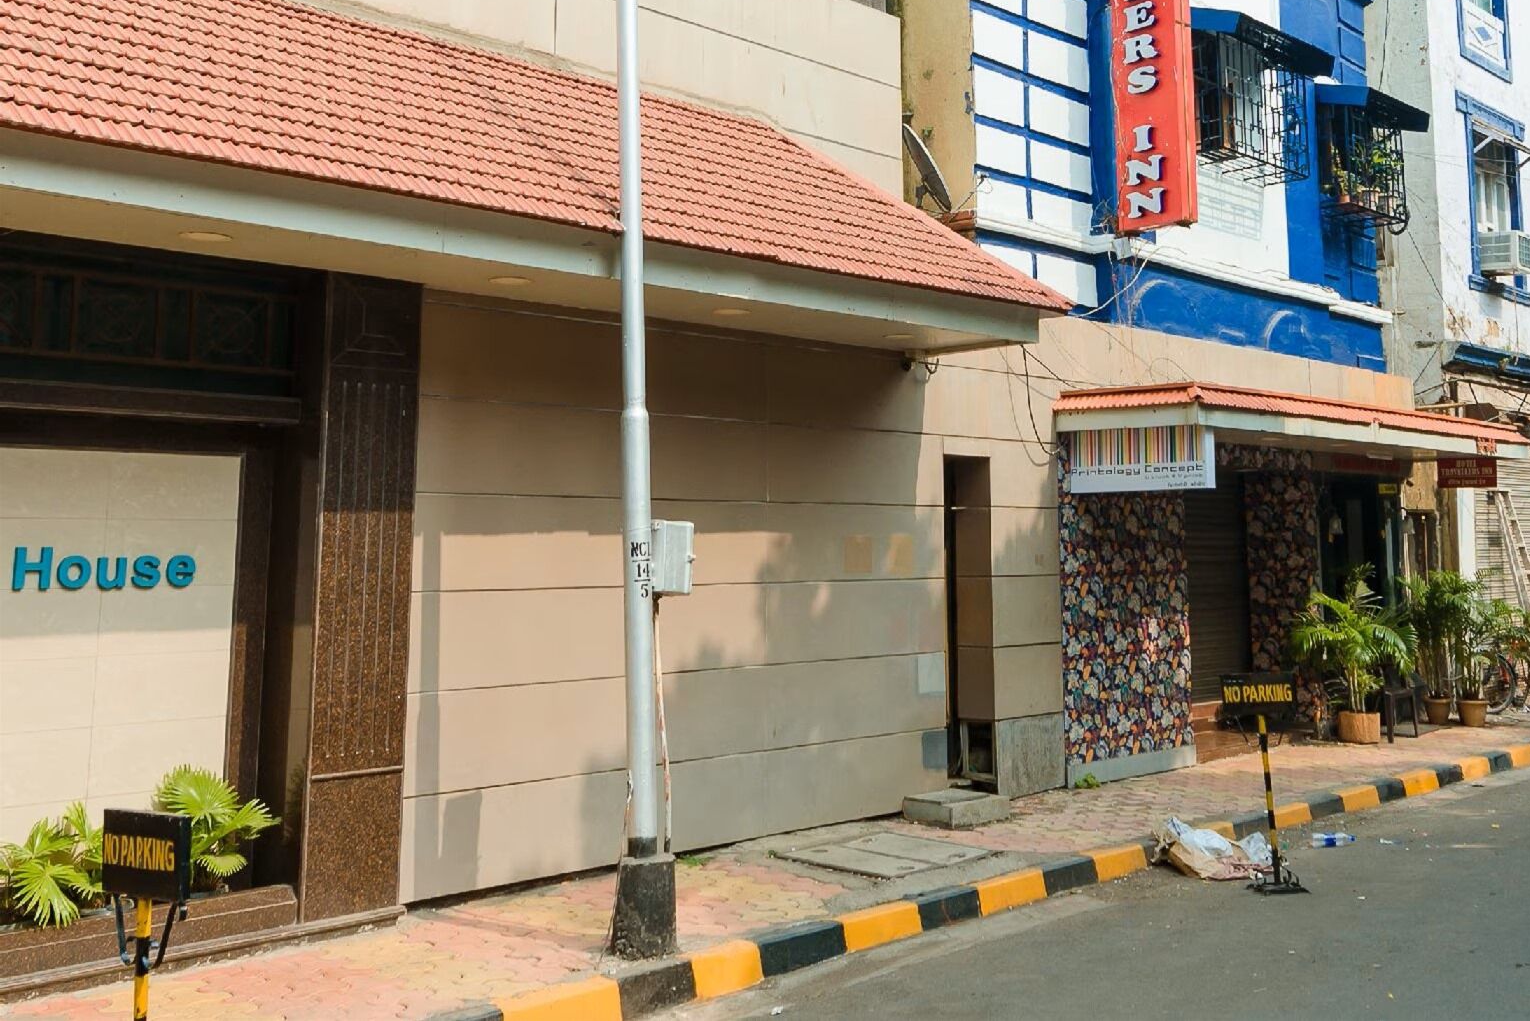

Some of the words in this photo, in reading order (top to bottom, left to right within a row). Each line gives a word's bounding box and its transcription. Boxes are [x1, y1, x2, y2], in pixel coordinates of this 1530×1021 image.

[1125, 124, 1164, 220] INN
[1071, 466, 1141, 477] Printology
[1144, 462, 1204, 474] Concept
[11, 546, 197, 592] House
[640, 583, 649, 599] 5
[1223, 685, 1241, 704] NO
[1242, 682, 1293, 703] PARKING
[103, 832, 119, 866] NO
[121, 835, 175, 872] PARKING
